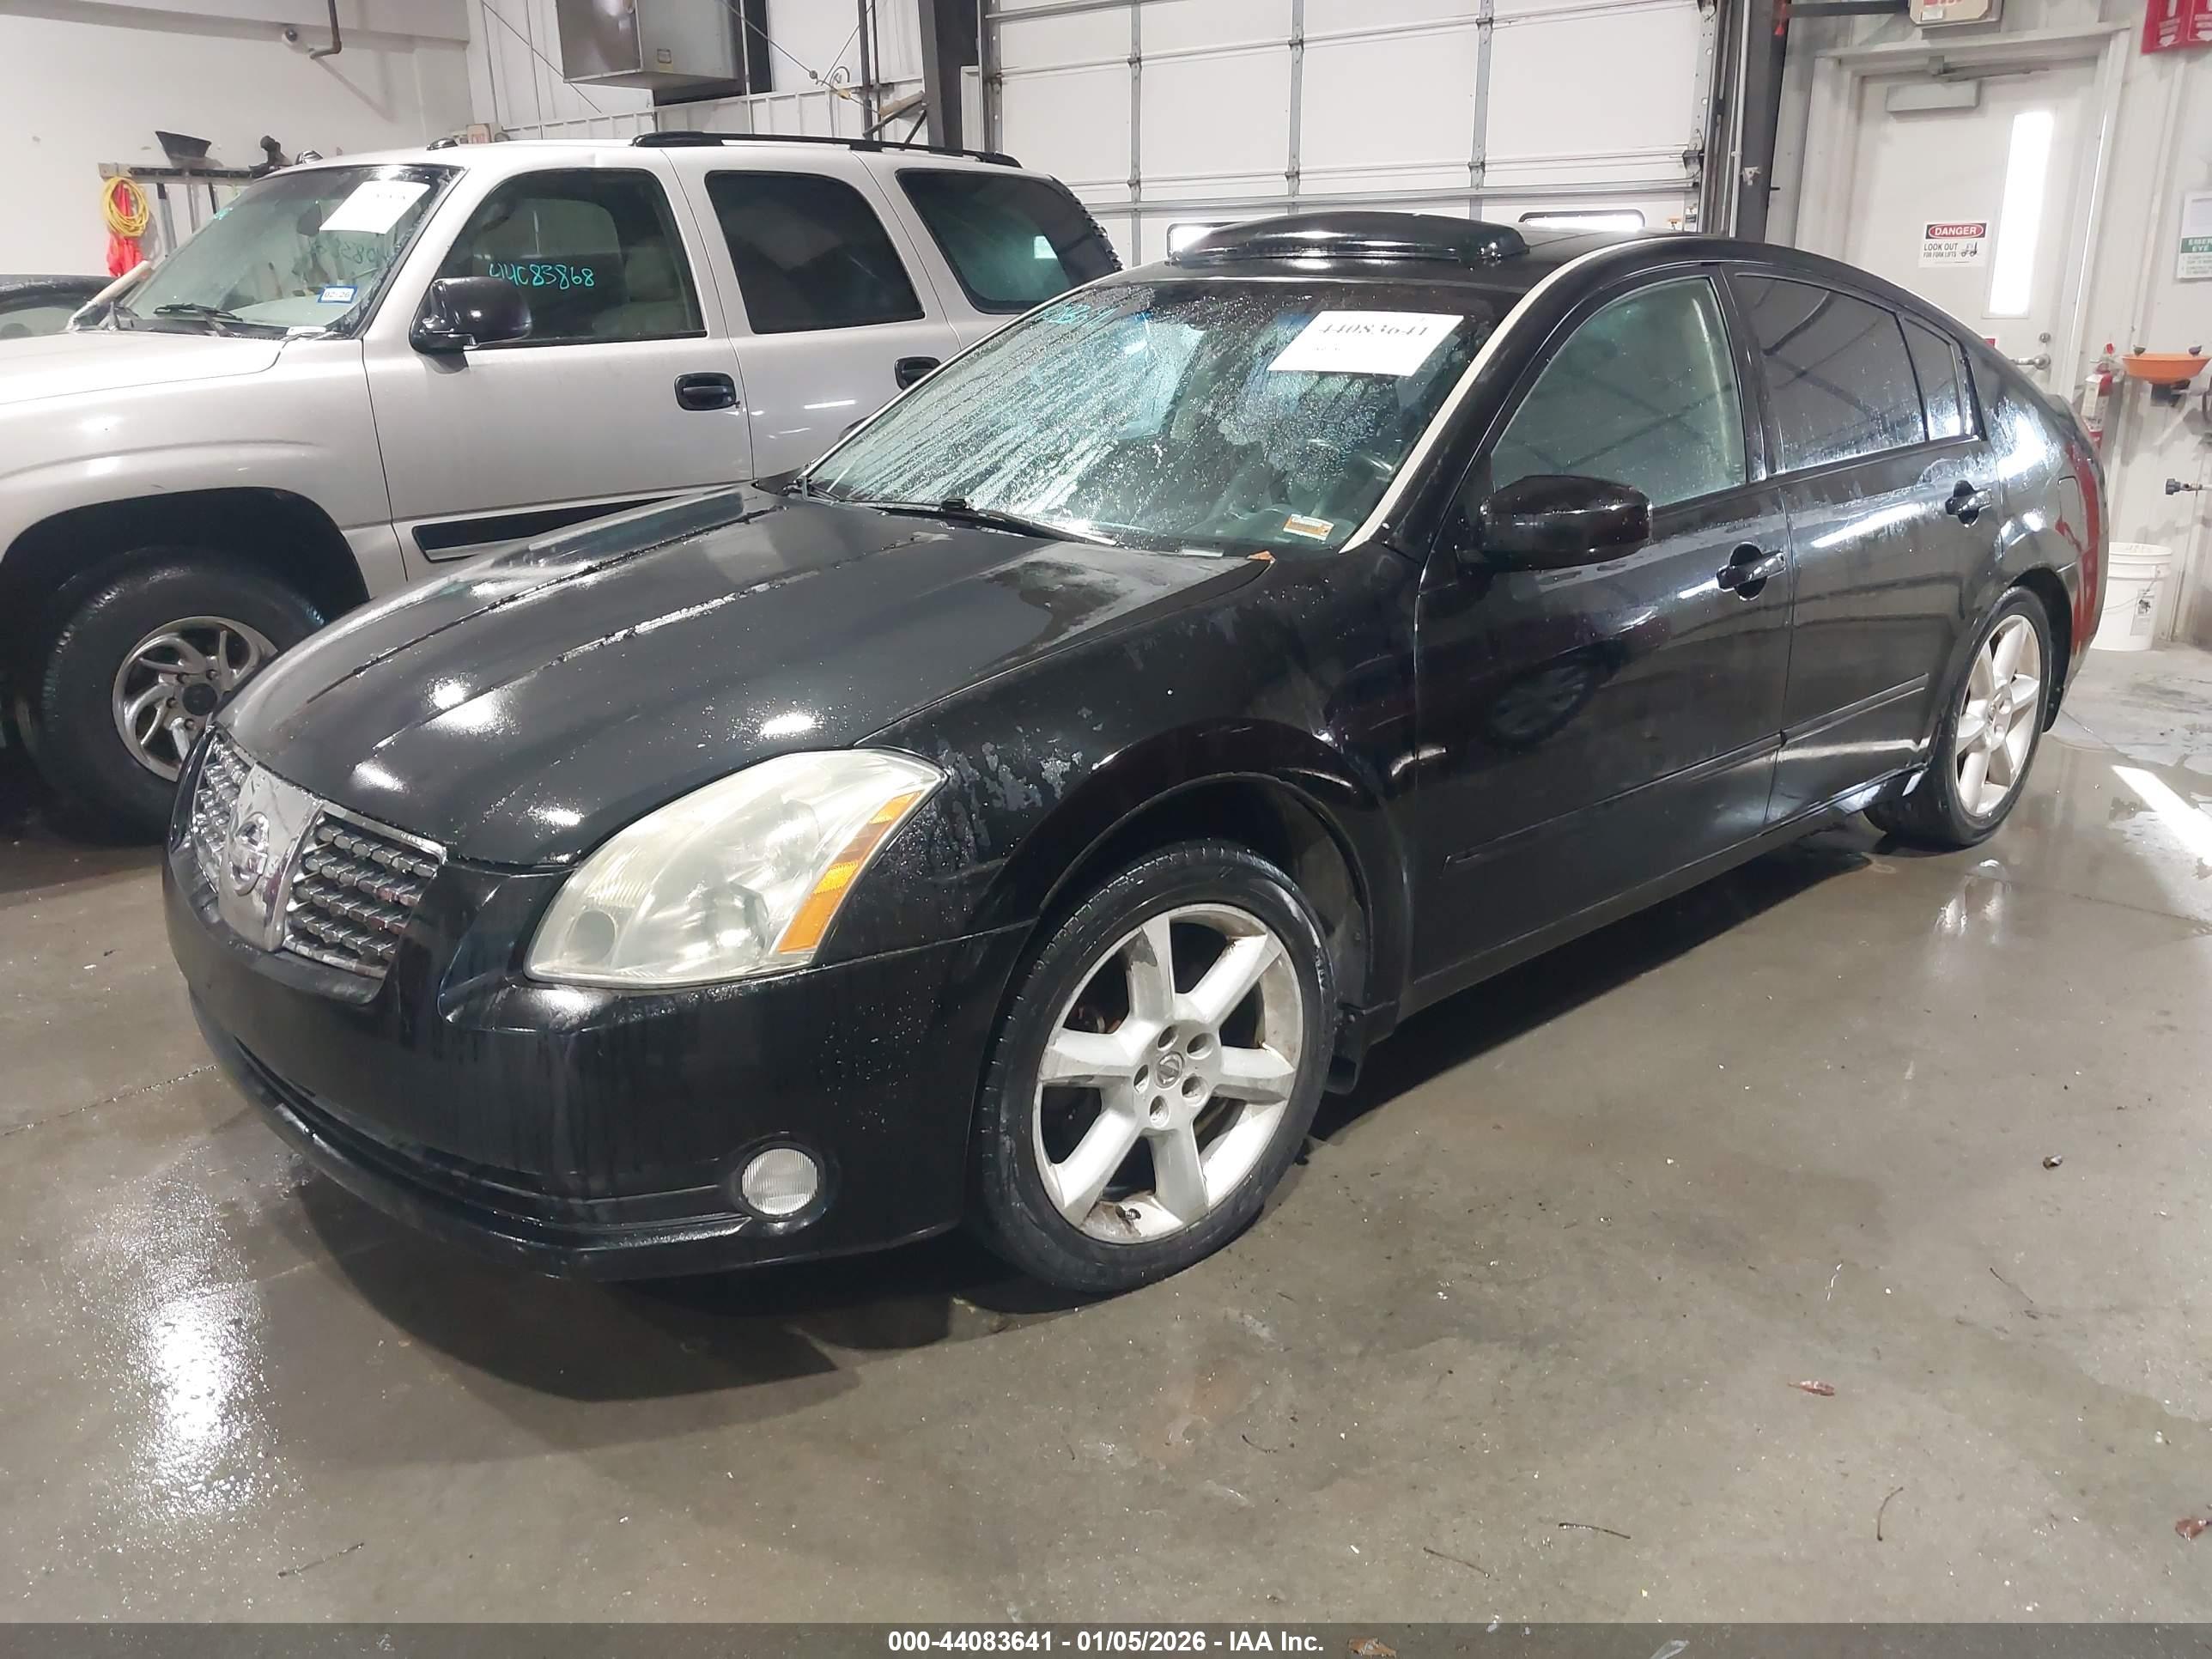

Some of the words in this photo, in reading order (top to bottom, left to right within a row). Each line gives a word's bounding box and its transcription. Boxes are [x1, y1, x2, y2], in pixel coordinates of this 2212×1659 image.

[1935, 227, 1977, 236] DANGER
[1923, 243, 1942, 252] LOOK
[1944, 242, 1958, 251] OUT
